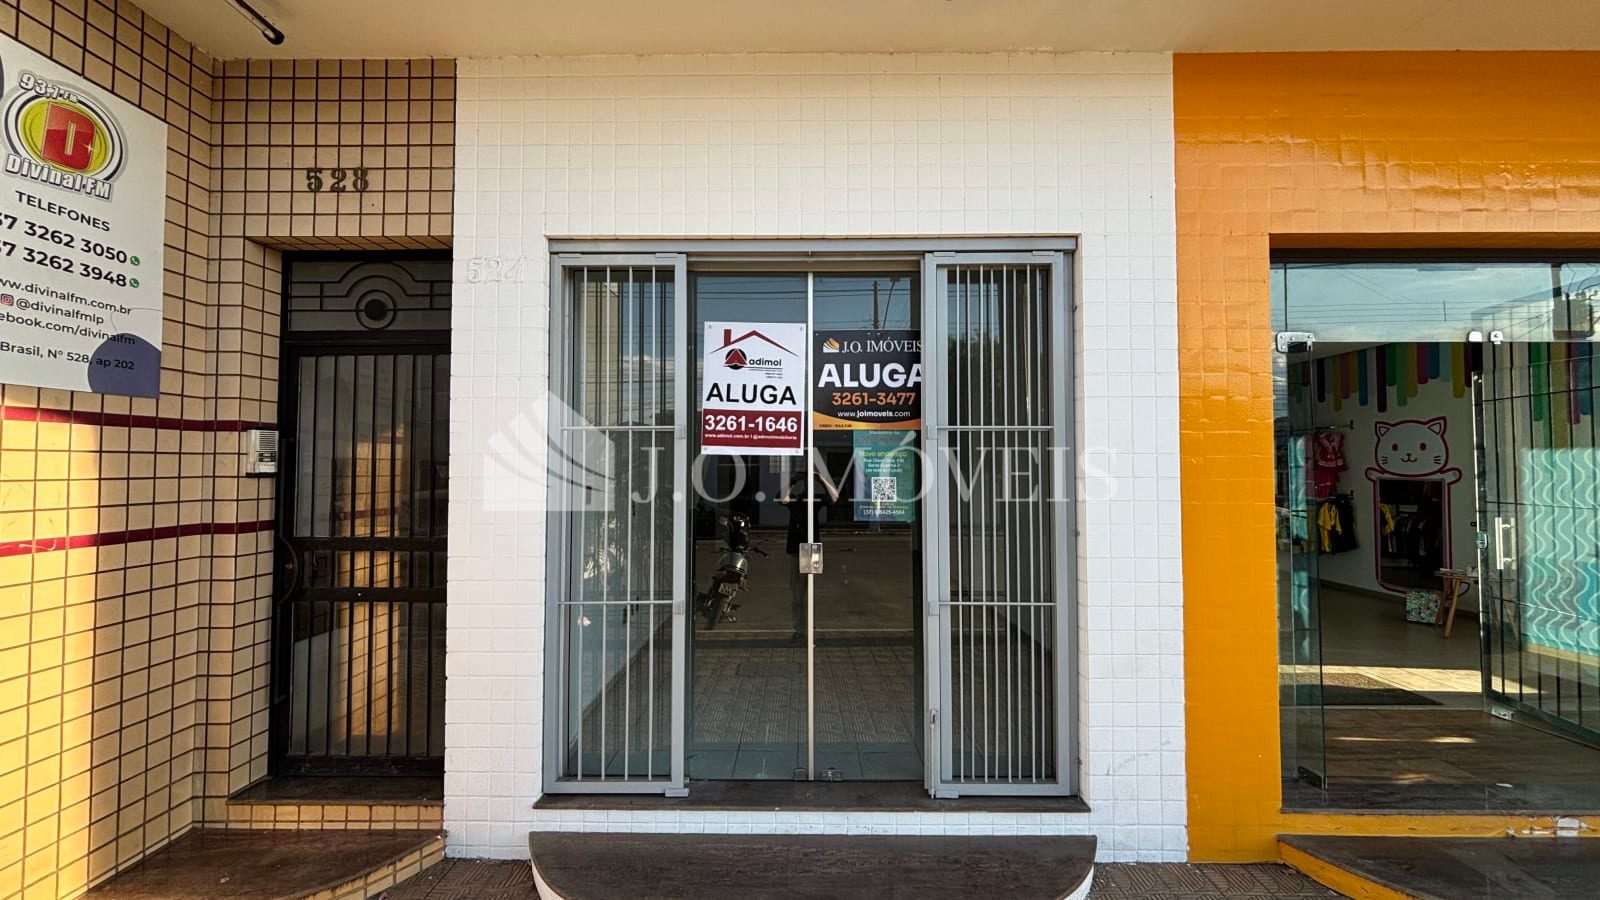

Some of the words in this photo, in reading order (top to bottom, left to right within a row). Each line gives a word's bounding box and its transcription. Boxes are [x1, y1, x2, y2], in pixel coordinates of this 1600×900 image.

[306, 167, 369, 192] 528
[15, 190, 110, 232] TELEFONES
[0, 212, 18, 229] 7
[24, 221, 75, 249] 3262
[80, 239, 128, 264] 3050
[0, 240, 17, 256] 7
[23, 246, 74, 273] 3262
[79, 263, 127, 287] 3948
[16, 298, 104, 325] @divinalfmlp
[0, 341, 43, 358] Brasil,
[66, 351, 92, 366] 528,
[96, 358, 111, 368] ap
[114, 359, 135, 370] 202
[748, 358, 782, 366] adimol
[818, 362, 922, 388] ALUGA
[706, 382, 797, 406] ALUGA
[832, 391, 916, 406] 3261-3477
[704, 414, 798, 433] 3261-1646
[837, 410, 911, 418] www.joimoveis.com
